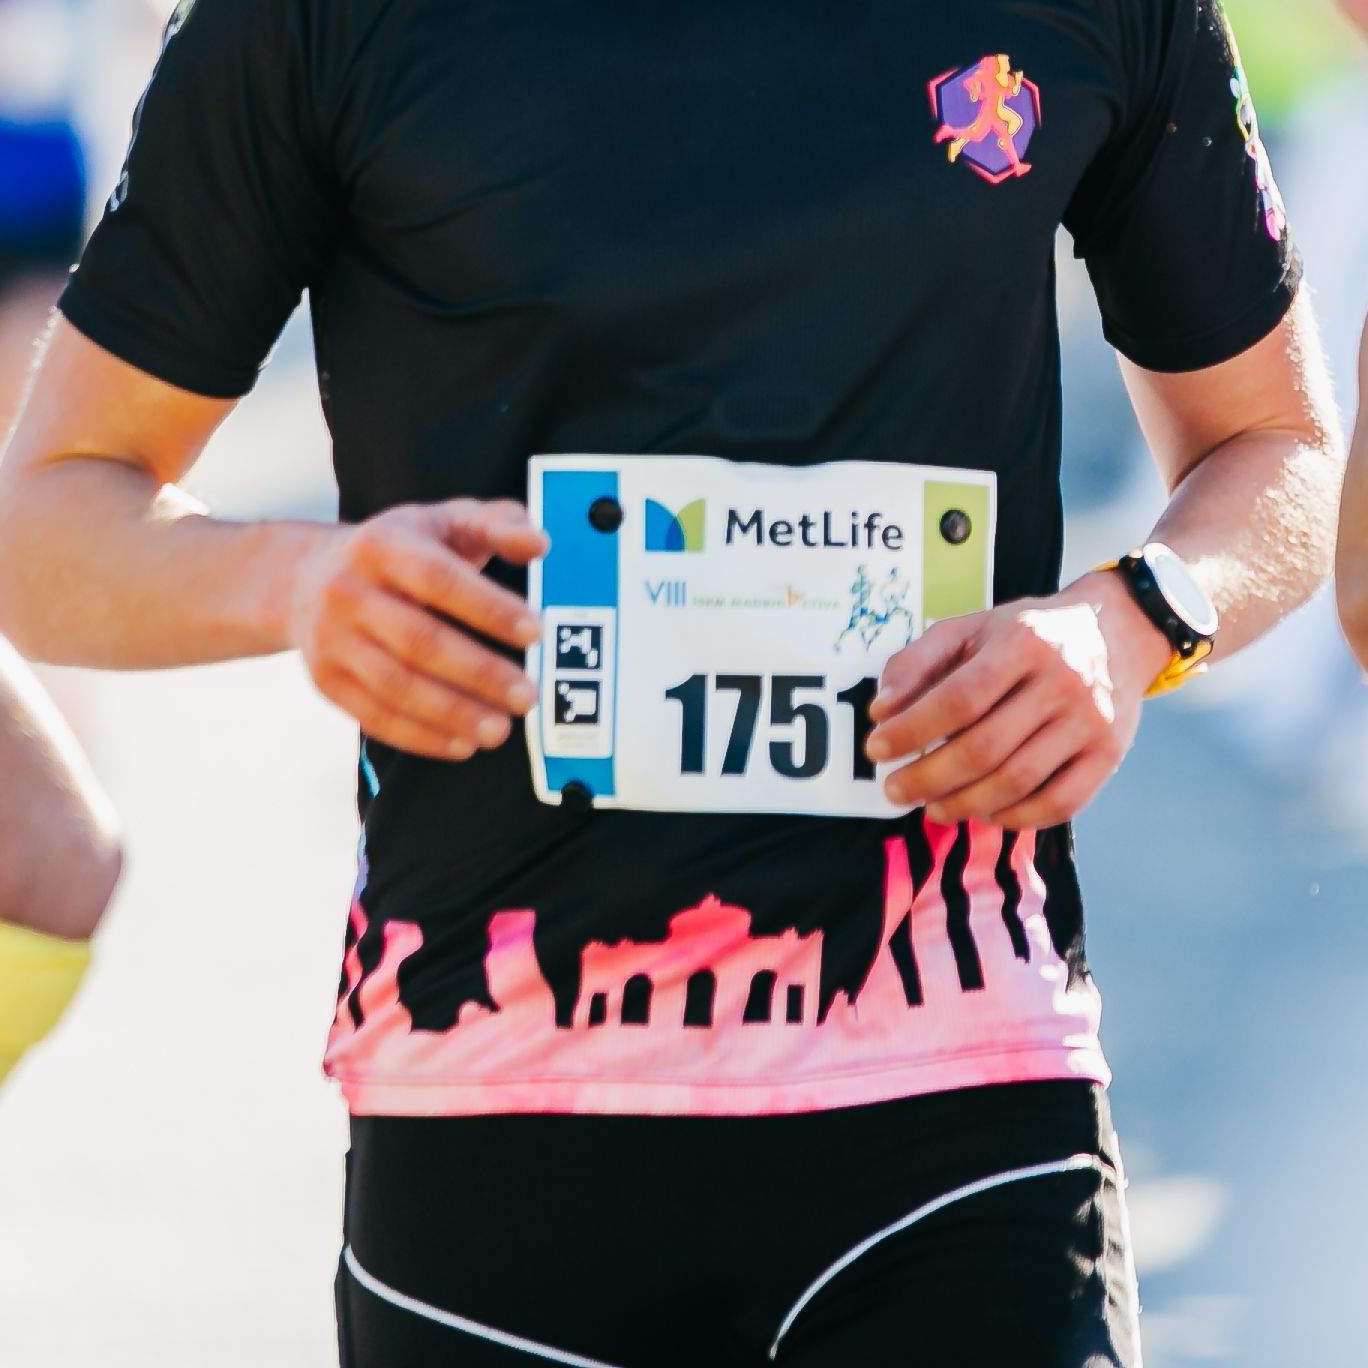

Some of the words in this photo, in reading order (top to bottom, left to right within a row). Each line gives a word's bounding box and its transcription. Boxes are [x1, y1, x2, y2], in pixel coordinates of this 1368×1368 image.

[725, 507, 905, 550] MetLife
[644, 580, 687, 608] VIII
[665, 673, 877, 781] 1751
